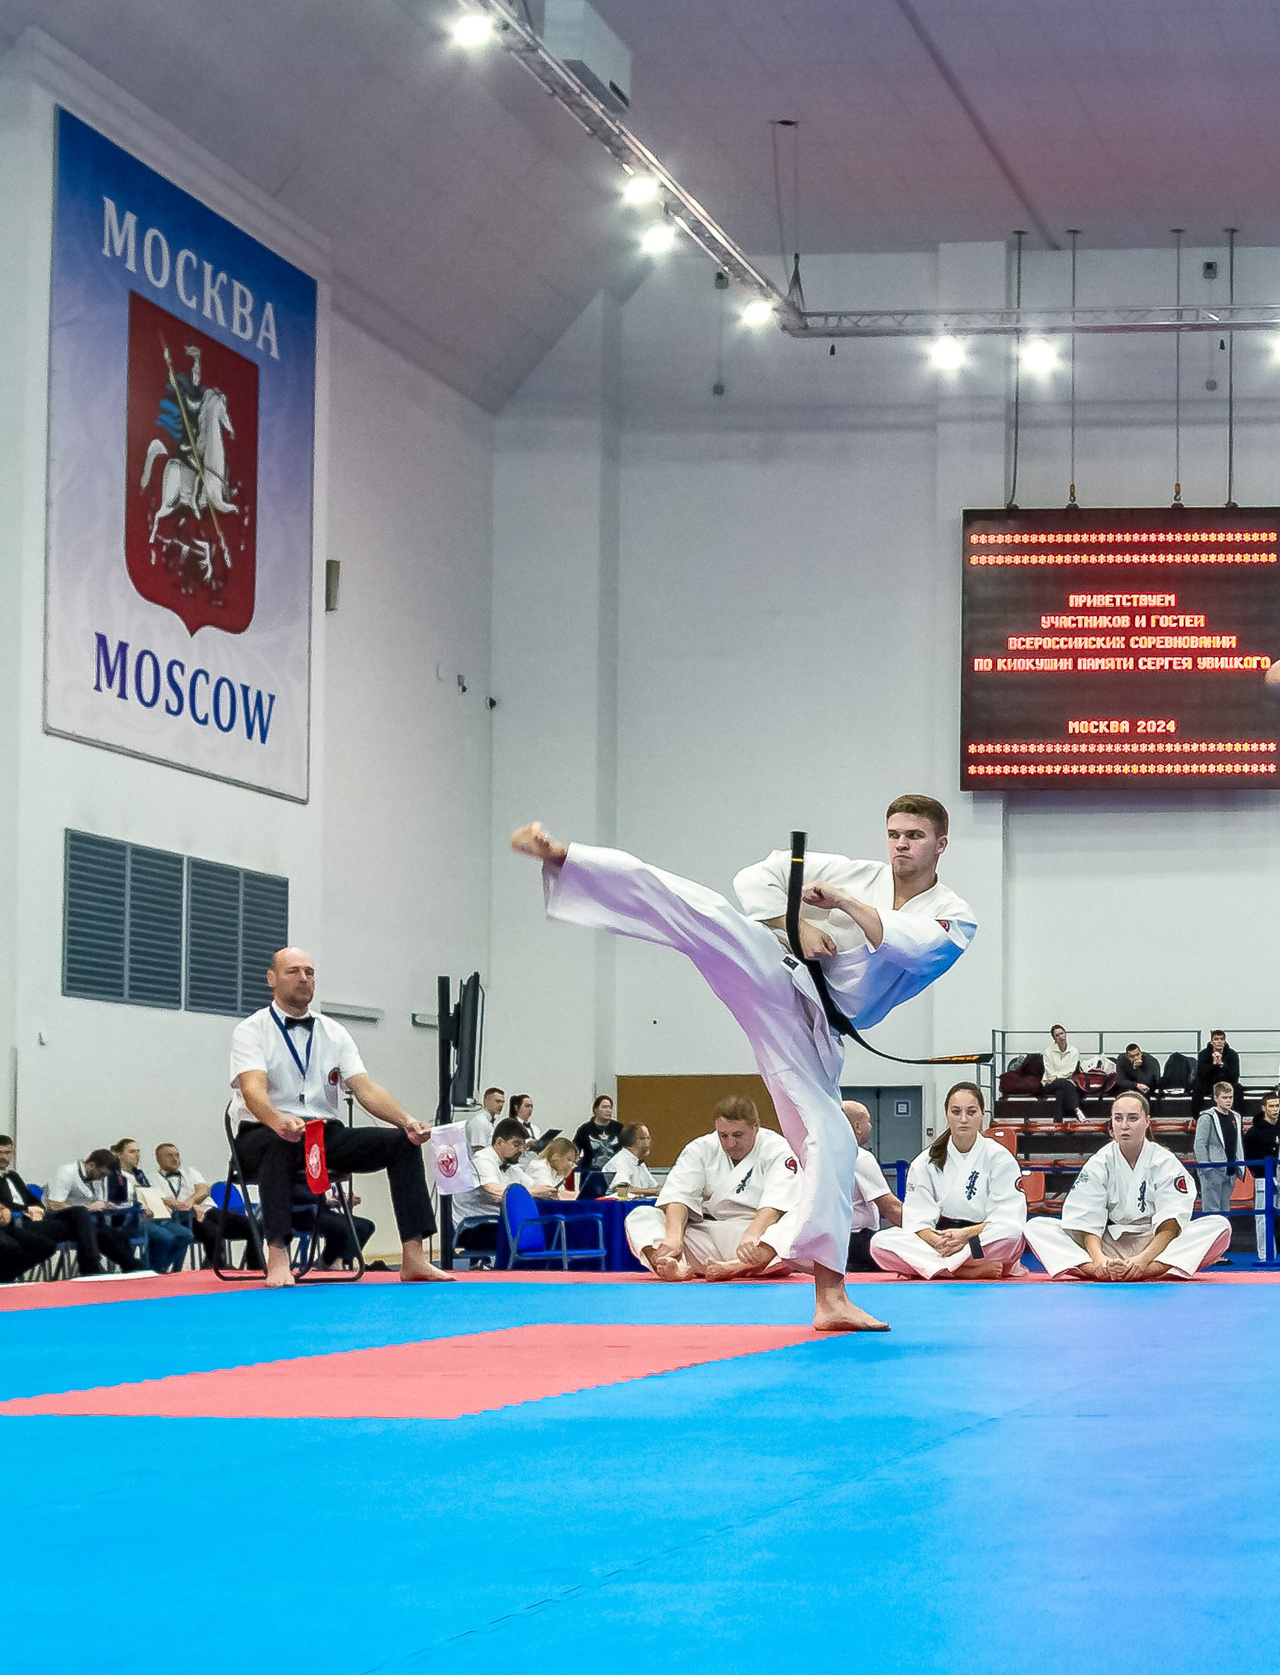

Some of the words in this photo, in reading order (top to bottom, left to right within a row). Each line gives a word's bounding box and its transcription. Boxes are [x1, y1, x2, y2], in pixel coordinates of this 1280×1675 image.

[102, 197, 280, 359] МОСКВА
[1068, 593, 1176, 608] ПРИВЕТСТВУЕМ
[1040, 615, 1131, 629] УЧАСТНИКОВ
[1134, 614, 1147, 628] И
[1150, 614, 1206, 628] ГОСТЕЙ
[1007, 636, 1126, 650] ВСЕРОССИЙСКИХ
[1129, 635, 1237, 649] СОРЕВНОВАНИЙ
[973, 658, 993, 672] ПО
[996, 658, 1074, 671] КИОКУШИН
[1077, 657, 1135, 671] ПАМЯТИ
[1137, 656, 1193, 670] СЕРГЕЯ
[1196, 656, 1272, 670] УВИЦКОГО
[94, 632, 275, 745] MOSCOW
[1068, 720, 1130, 734] МОСКВА
[1136, 720, 1176, 733] 2024
